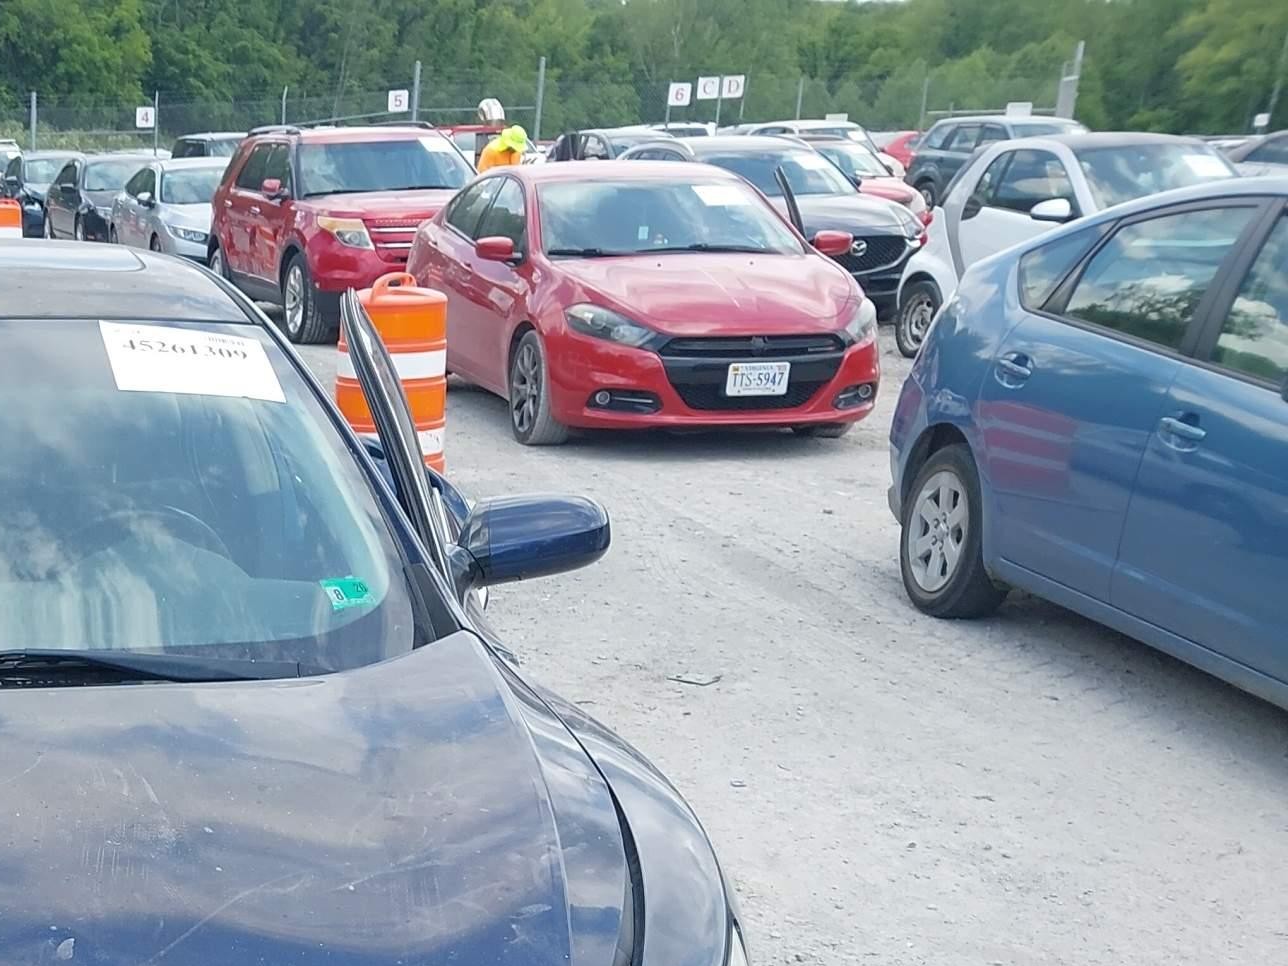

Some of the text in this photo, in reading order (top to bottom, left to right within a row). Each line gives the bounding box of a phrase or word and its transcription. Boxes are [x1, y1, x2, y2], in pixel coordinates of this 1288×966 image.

[727, 79, 740, 94] D
[394, 94, 402, 107] 5
[675, 87, 685, 101] 6
[141, 111, 149, 123] 4
[123, 338, 248, 360] 45261309
[732, 372, 785, 387] TTS-5947
[333, 588, 345, 601] 8
